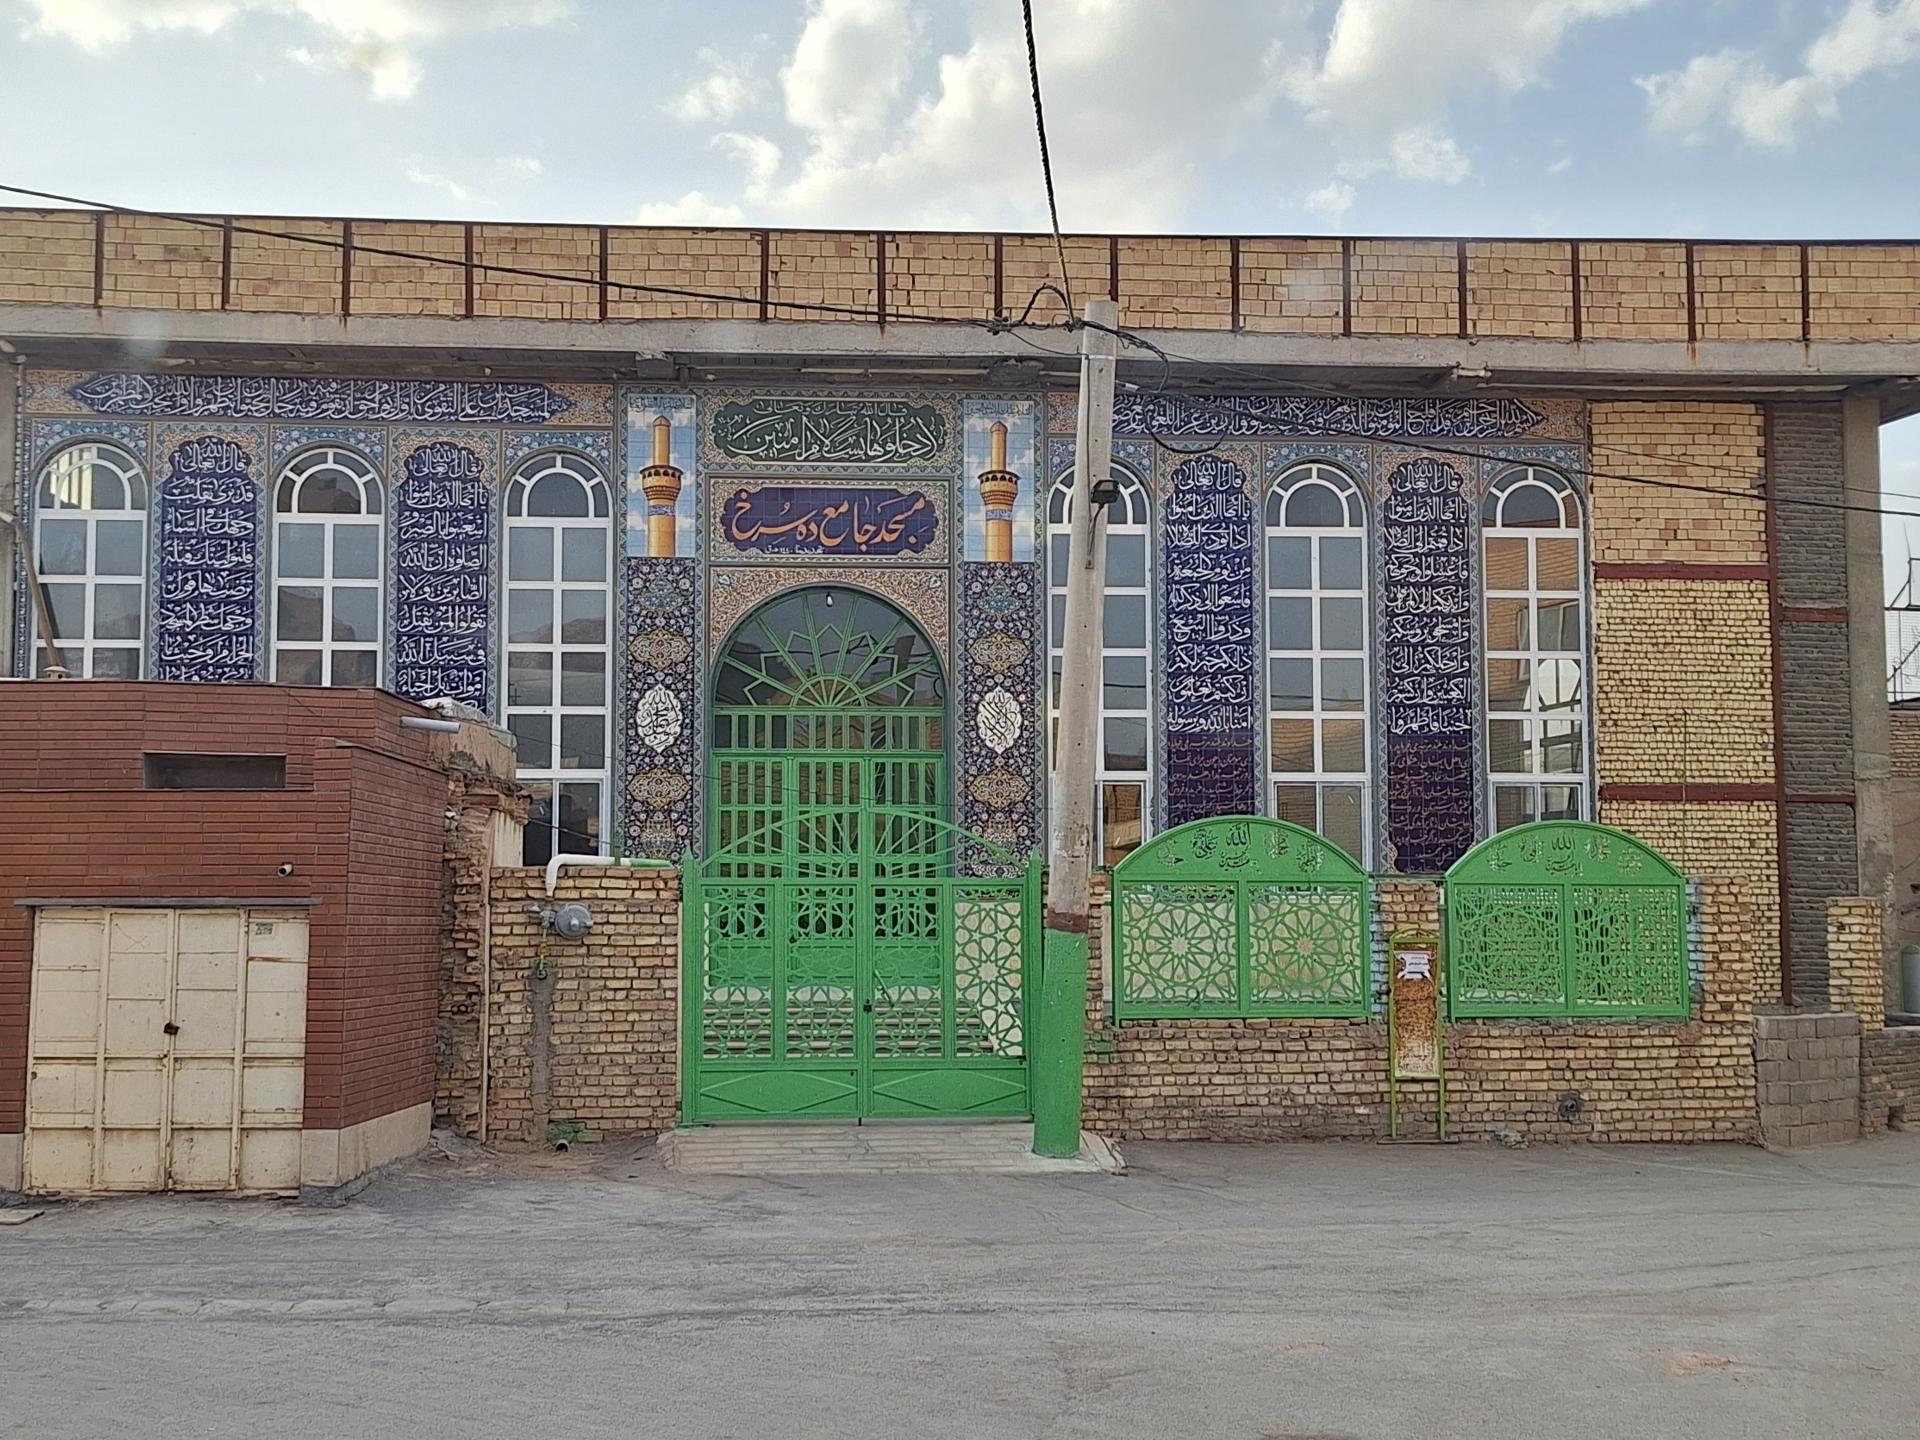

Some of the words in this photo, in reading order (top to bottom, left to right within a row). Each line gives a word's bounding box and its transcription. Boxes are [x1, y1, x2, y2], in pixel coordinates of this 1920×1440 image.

[819, 496, 877, 551] جامع
[870, 496, 925, 544] مسجد
[1226, 822, 1251, 847] الله
